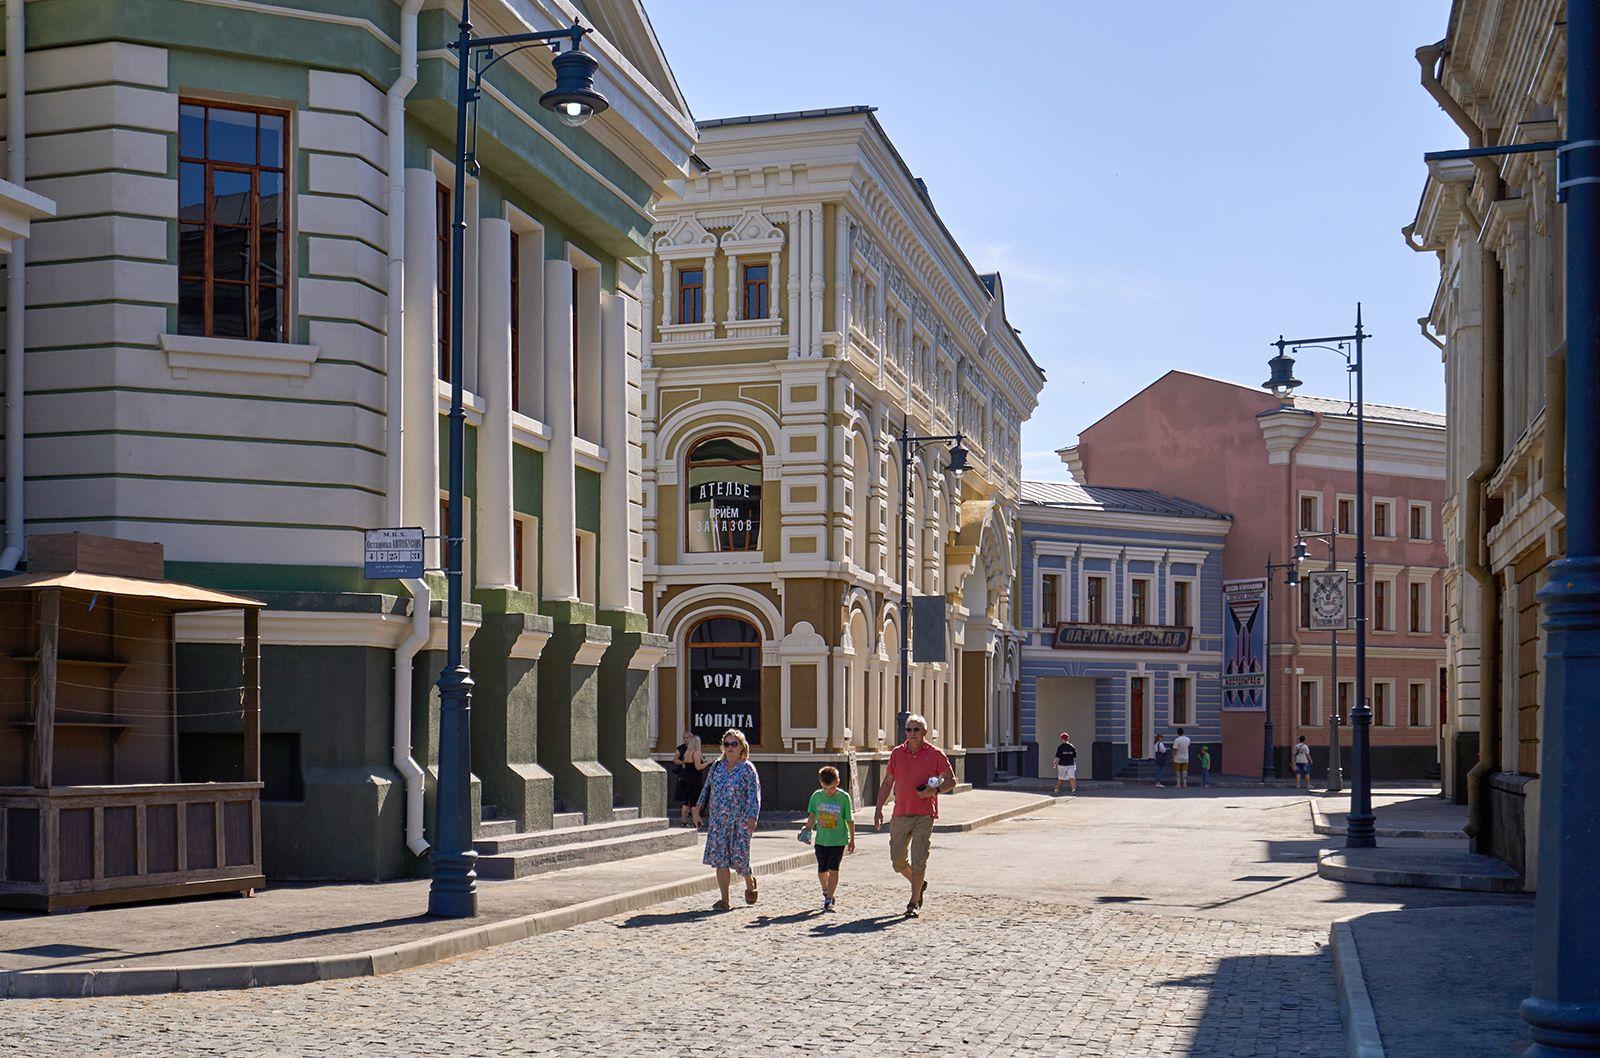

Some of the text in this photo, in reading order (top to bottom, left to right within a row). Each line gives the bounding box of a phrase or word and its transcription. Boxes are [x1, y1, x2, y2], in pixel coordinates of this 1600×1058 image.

[699, 481, 750, 499] АТЕЛЬЕ
[380, 552, 385, 560] 7
[389, 552, 398, 560] 25
[411, 552, 420, 560] 31
[1066, 629, 1181, 646] ПАРИКМАХЕРСКАЯ
[703, 673, 742, 689] РОГА
[694, 713, 753, 728] КОПЫТА
